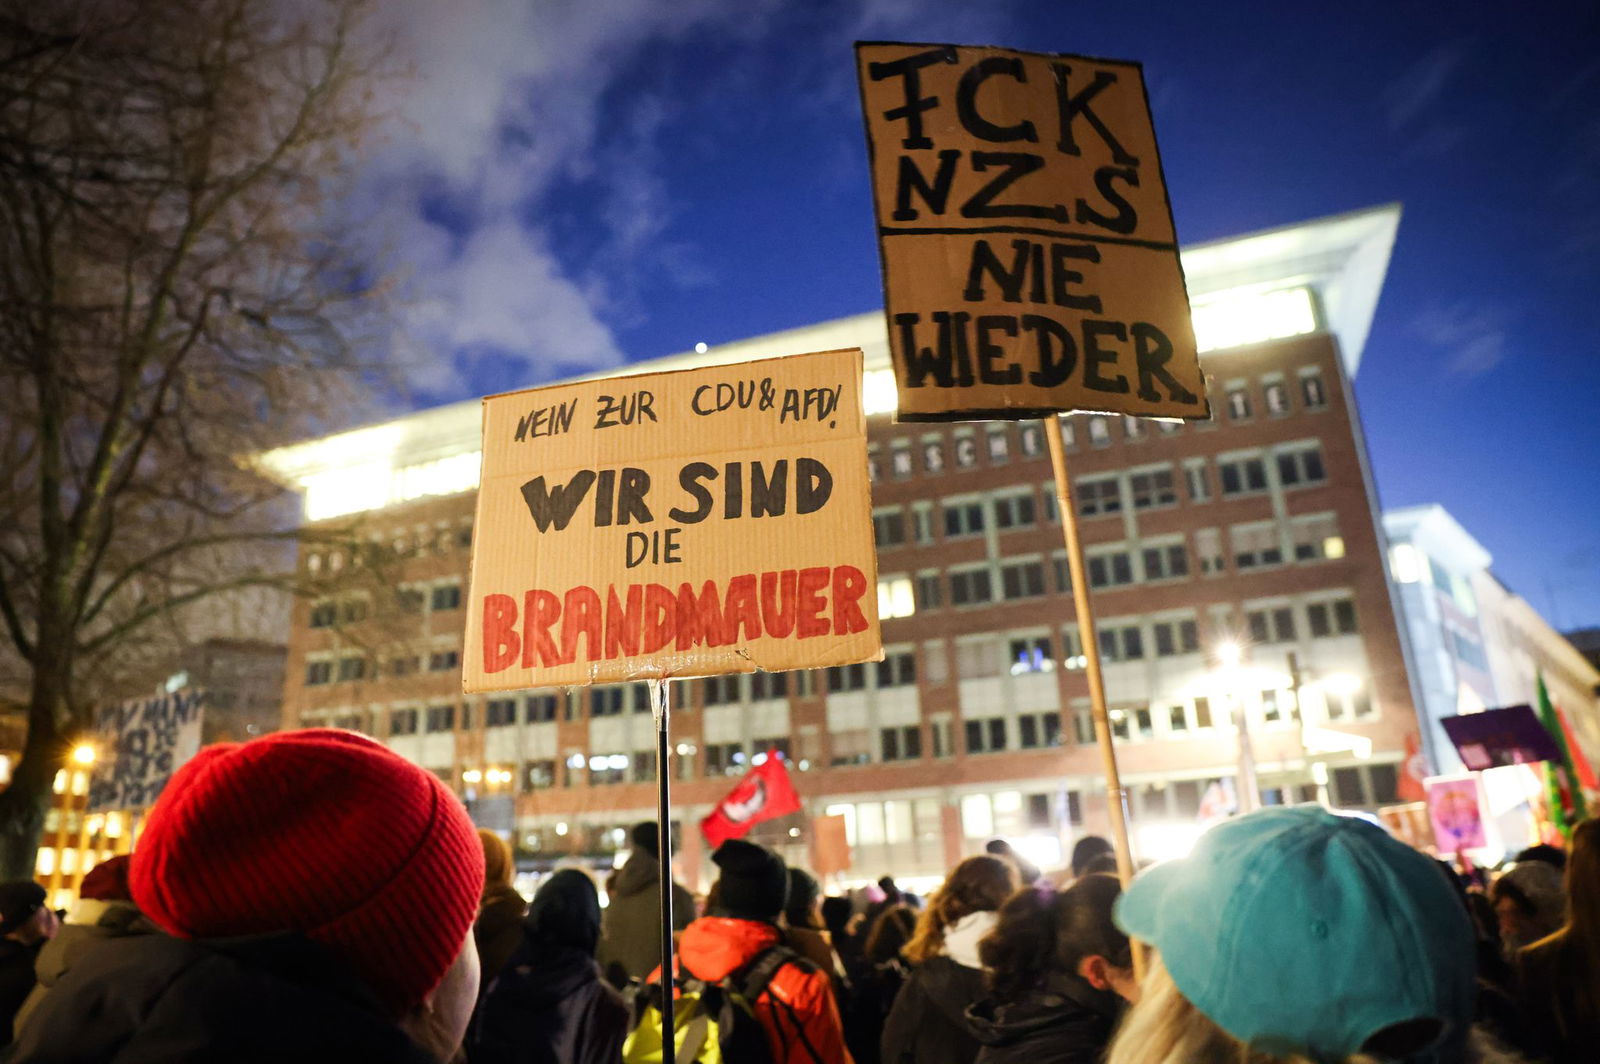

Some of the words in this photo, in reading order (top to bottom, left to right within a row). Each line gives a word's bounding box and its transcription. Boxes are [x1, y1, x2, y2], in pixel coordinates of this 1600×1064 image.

[870, 47, 1140, 168] FCK
[892, 149, 1140, 234] NZS
[963, 240, 1103, 314] NIE
[895, 311, 1197, 404] WIEDER
[514, 398, 577, 443] NEIN
[594, 391, 658, 429] ZUR
[520, 467, 654, 534] WIR
[668, 458, 833, 525] SIND
[626, 528, 682, 568] DIE
[483, 565, 869, 673] BRANDMAUER
